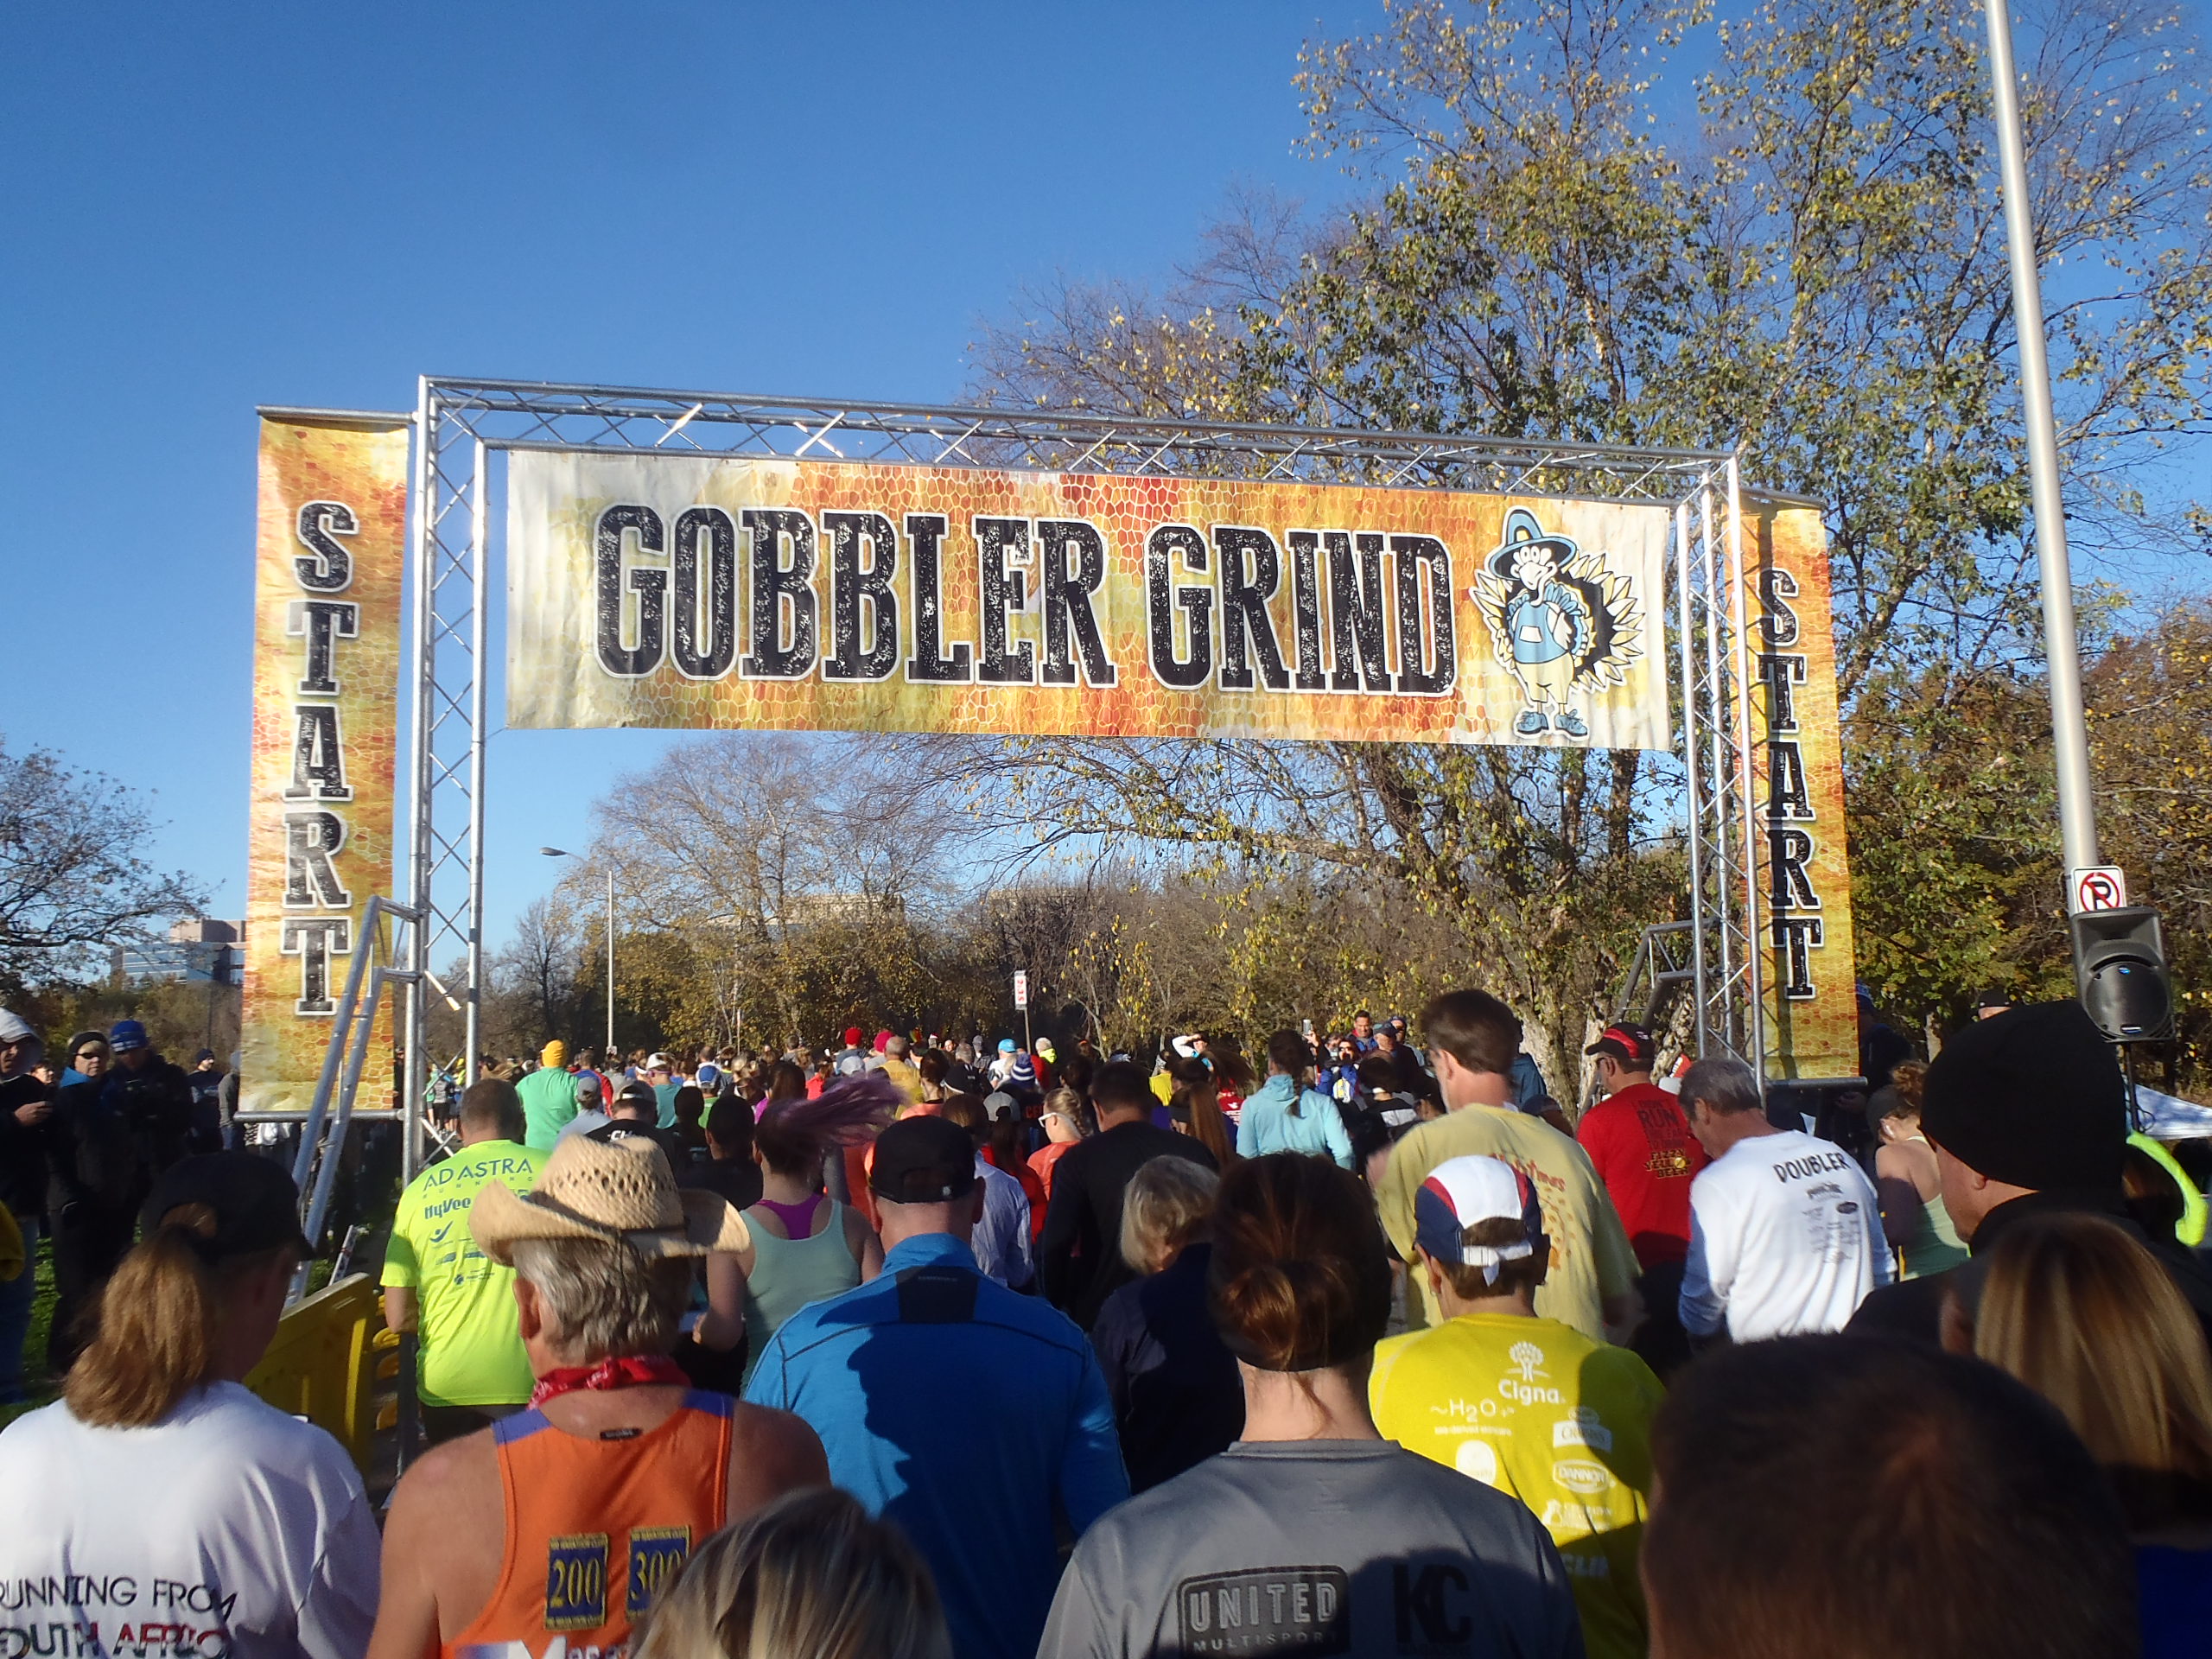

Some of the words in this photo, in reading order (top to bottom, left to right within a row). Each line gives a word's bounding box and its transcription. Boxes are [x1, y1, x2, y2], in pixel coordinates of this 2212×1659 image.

[594, 505, 1117, 689] GOBBLER
[1146, 522, 1459, 698] GRIND
[280, 499, 359, 1017] START
[1755, 566, 1822, 999] START
[457, 1158, 533, 1181] ASTRA
[1772, 1152, 1852, 1183] DOUBLER
[550, 1558, 601, 1608] 200
[1190, 1581, 1338, 1633] UNITED
[1392, 1563, 1472, 1643] KC
